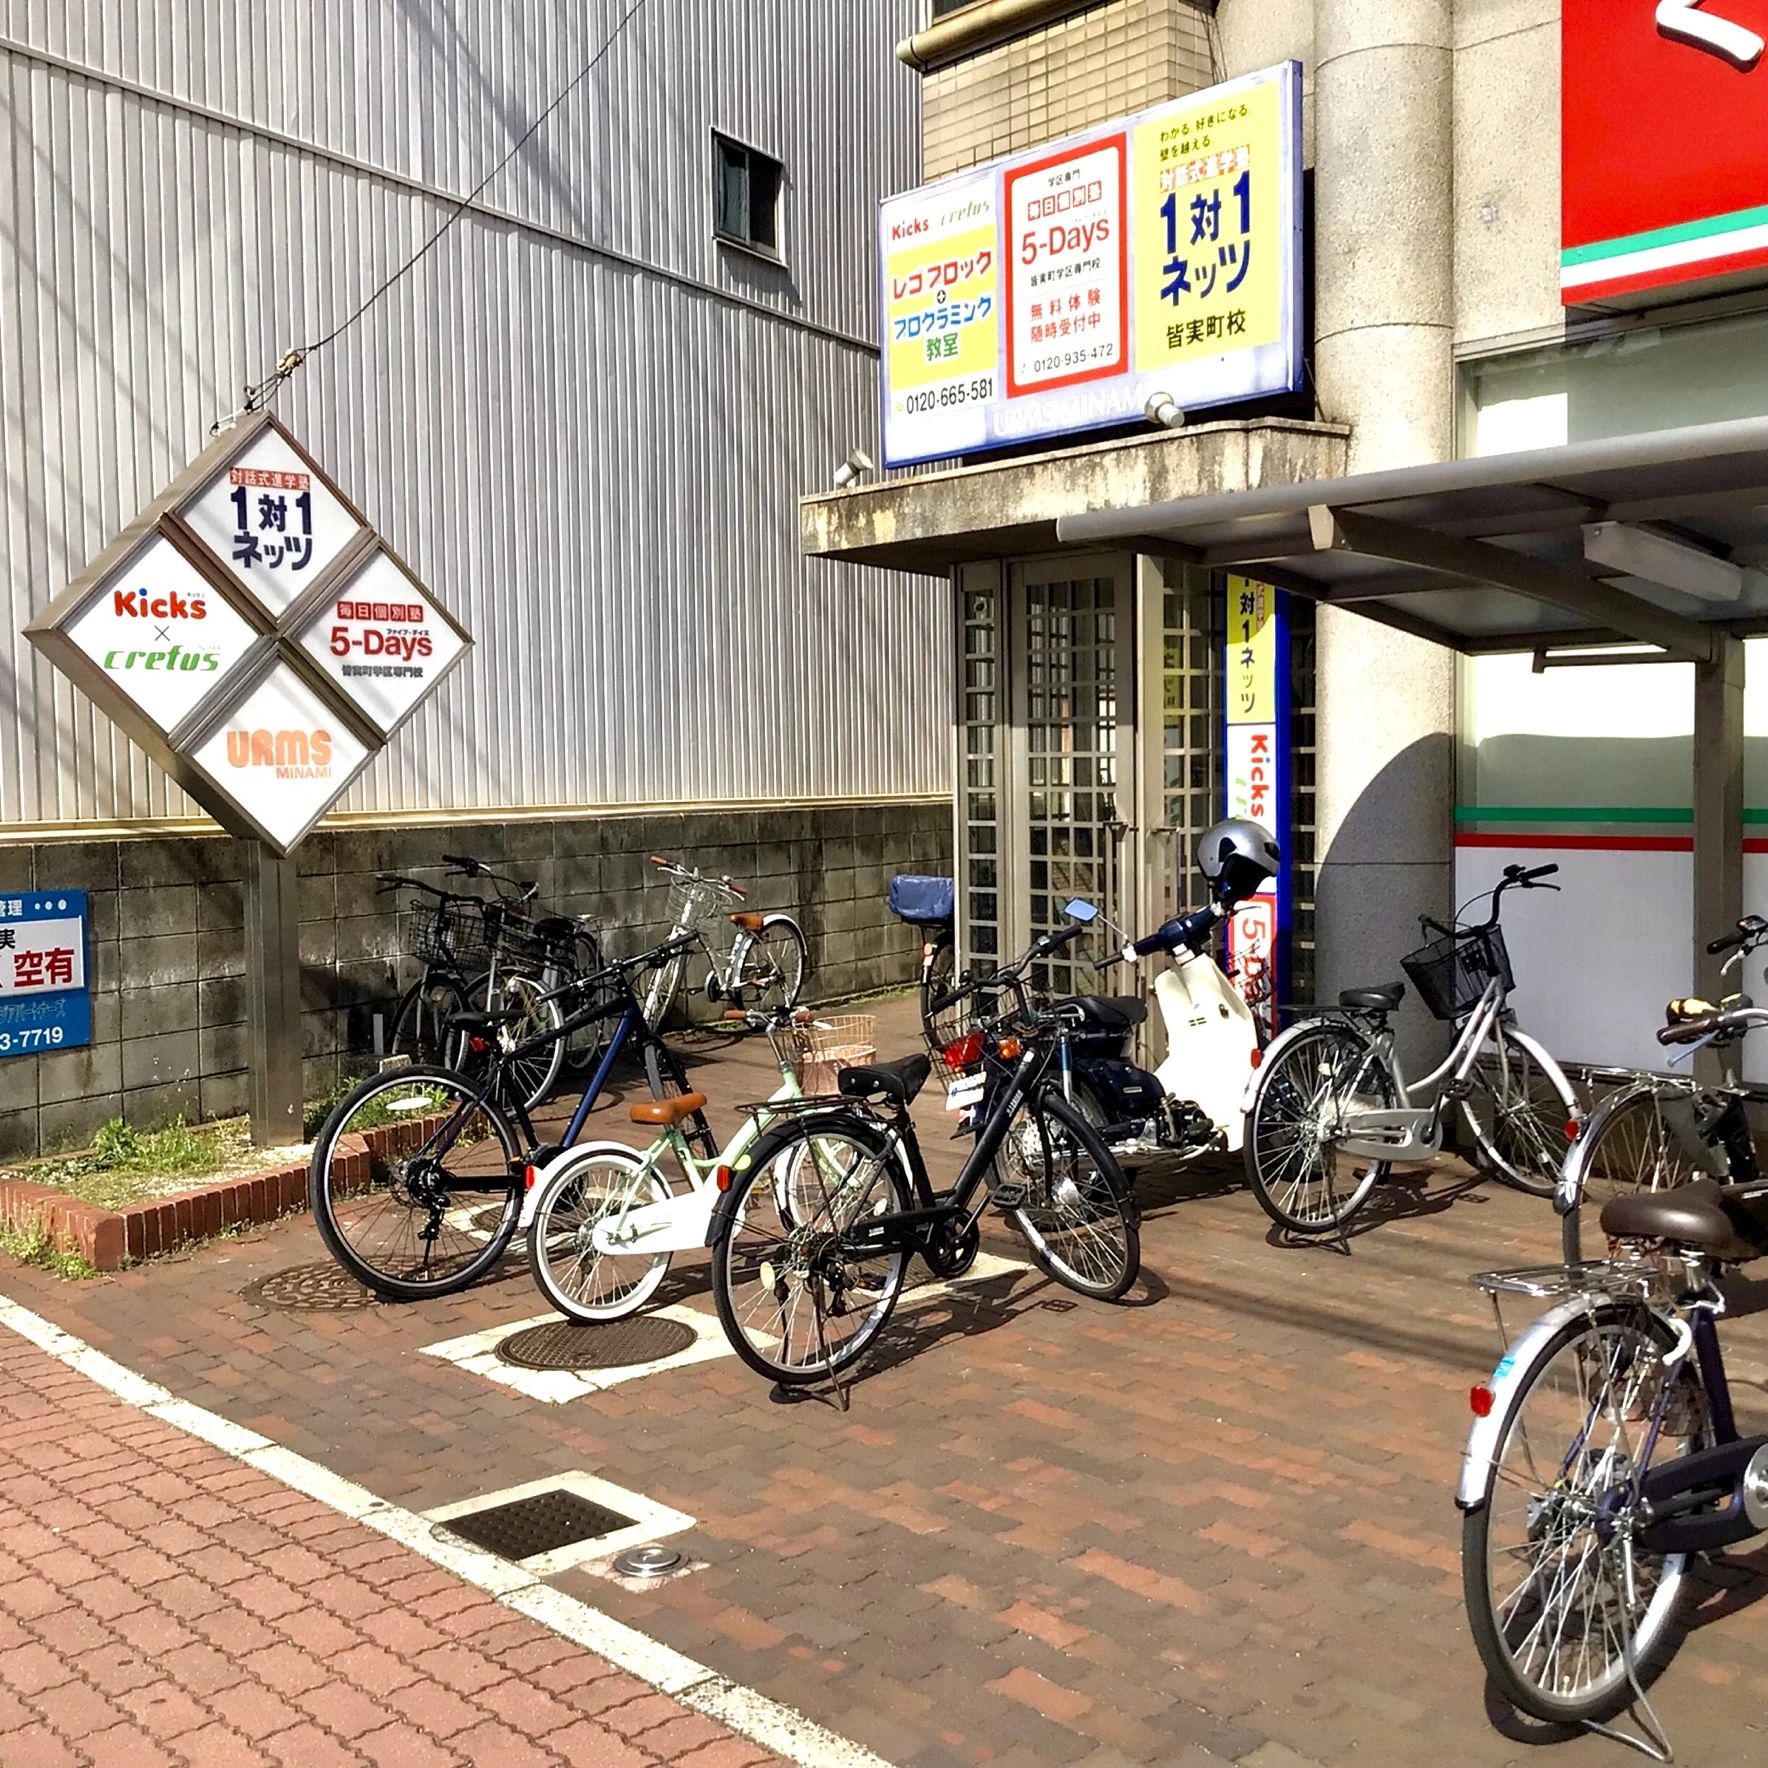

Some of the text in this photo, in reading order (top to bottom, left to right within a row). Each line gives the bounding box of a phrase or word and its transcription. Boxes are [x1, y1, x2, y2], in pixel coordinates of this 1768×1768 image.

[892, 217, 930, 241] Kicks
[1160, 170, 1250, 255] 1対1
[1021, 217, 1110, 265] 5-Days
[1160, 239, 1250, 307] ネッツ
[1031, 287, 1101, 321] 無料体験
[926, 333, 959, 361] 教室
[1031, 311, 1101, 344] 随時受付中
[1166, 309, 1246, 350] 皆実町校
[230, 486, 312, 535] 1対1
[232, 531, 313, 571] ネッツ
[114, 588, 207, 620] Kicks
[330, 626, 433, 662] 5-Days
[276, 767, 332, 780] MINAMI
[1250, 735, 1270, 817] Kicks
[14, 947, 75, 988] 空有
